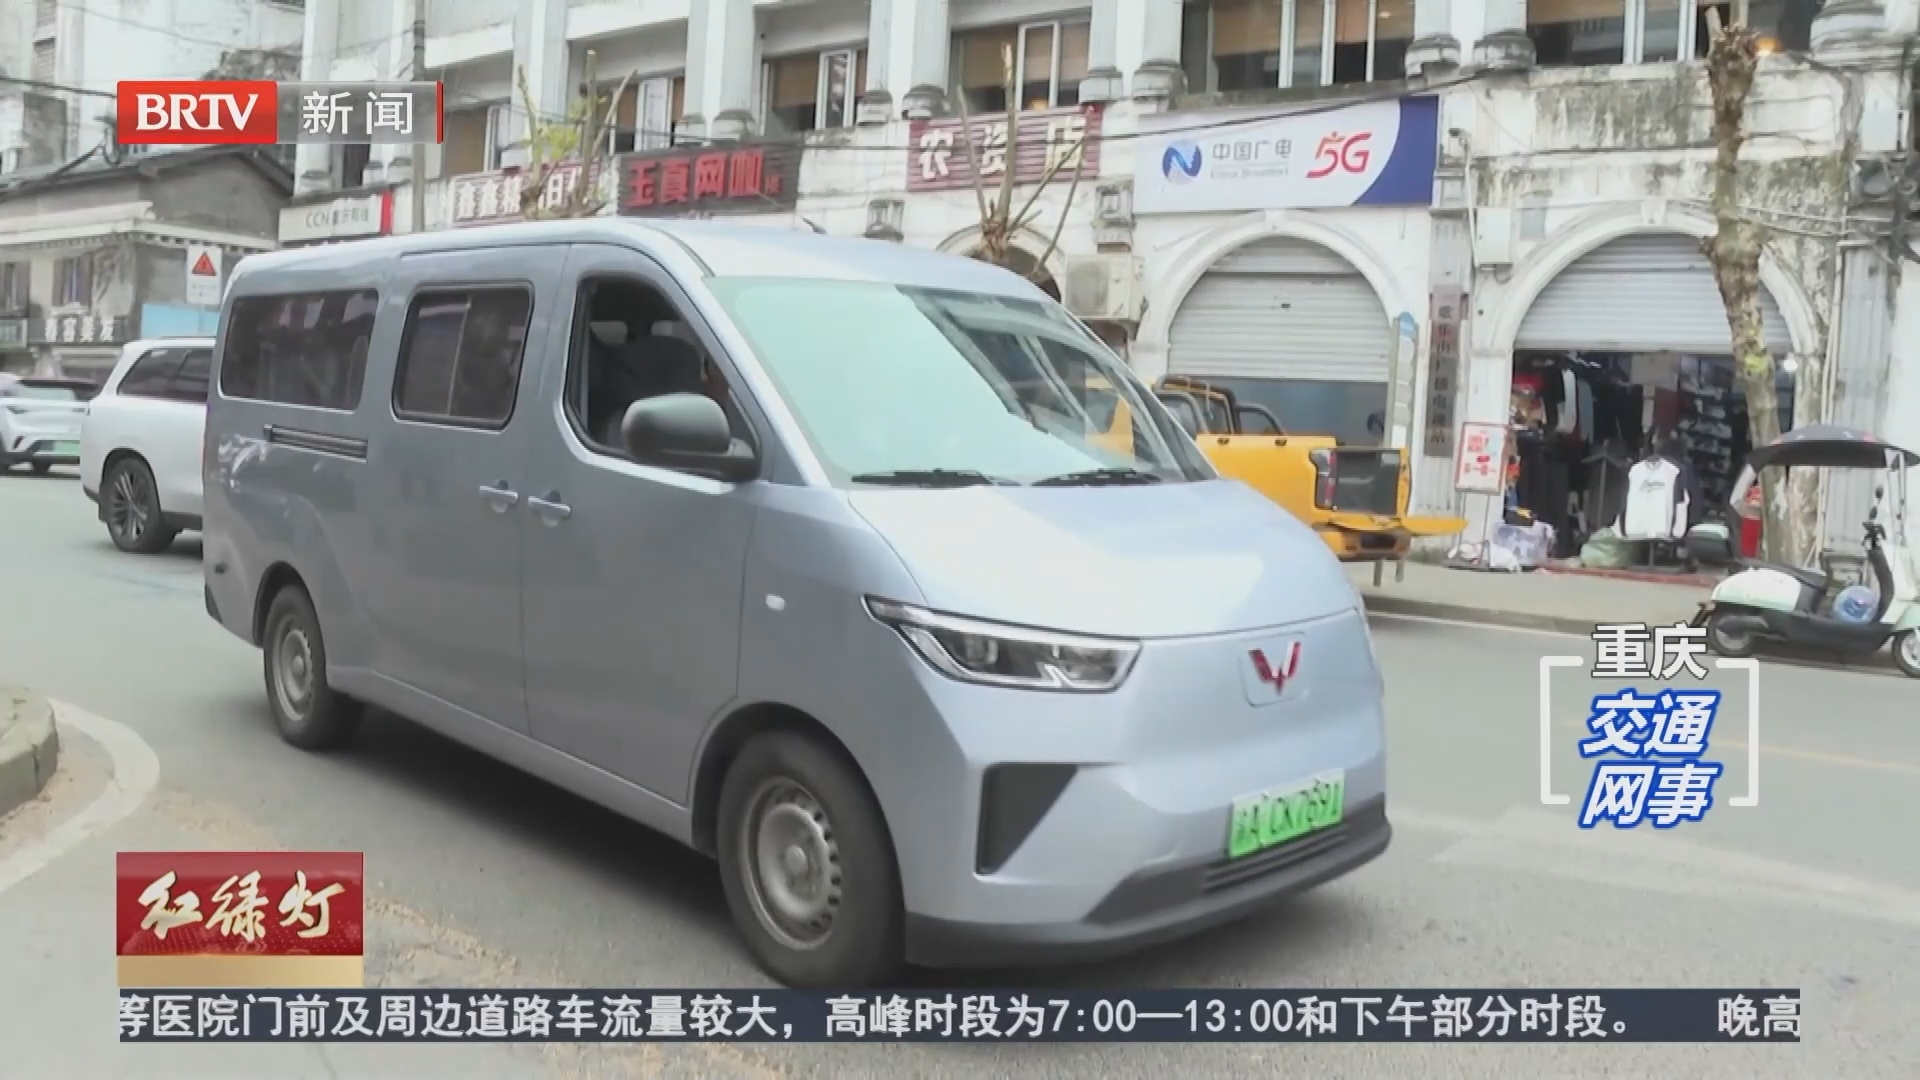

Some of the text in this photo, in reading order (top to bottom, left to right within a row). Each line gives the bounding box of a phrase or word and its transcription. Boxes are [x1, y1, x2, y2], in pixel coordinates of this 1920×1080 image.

[919, 115, 1086, 180] 农资店
[1212, 131, 1372, 179] 中国广电 5G
[626, 149, 764, 207] 玉真网咖
